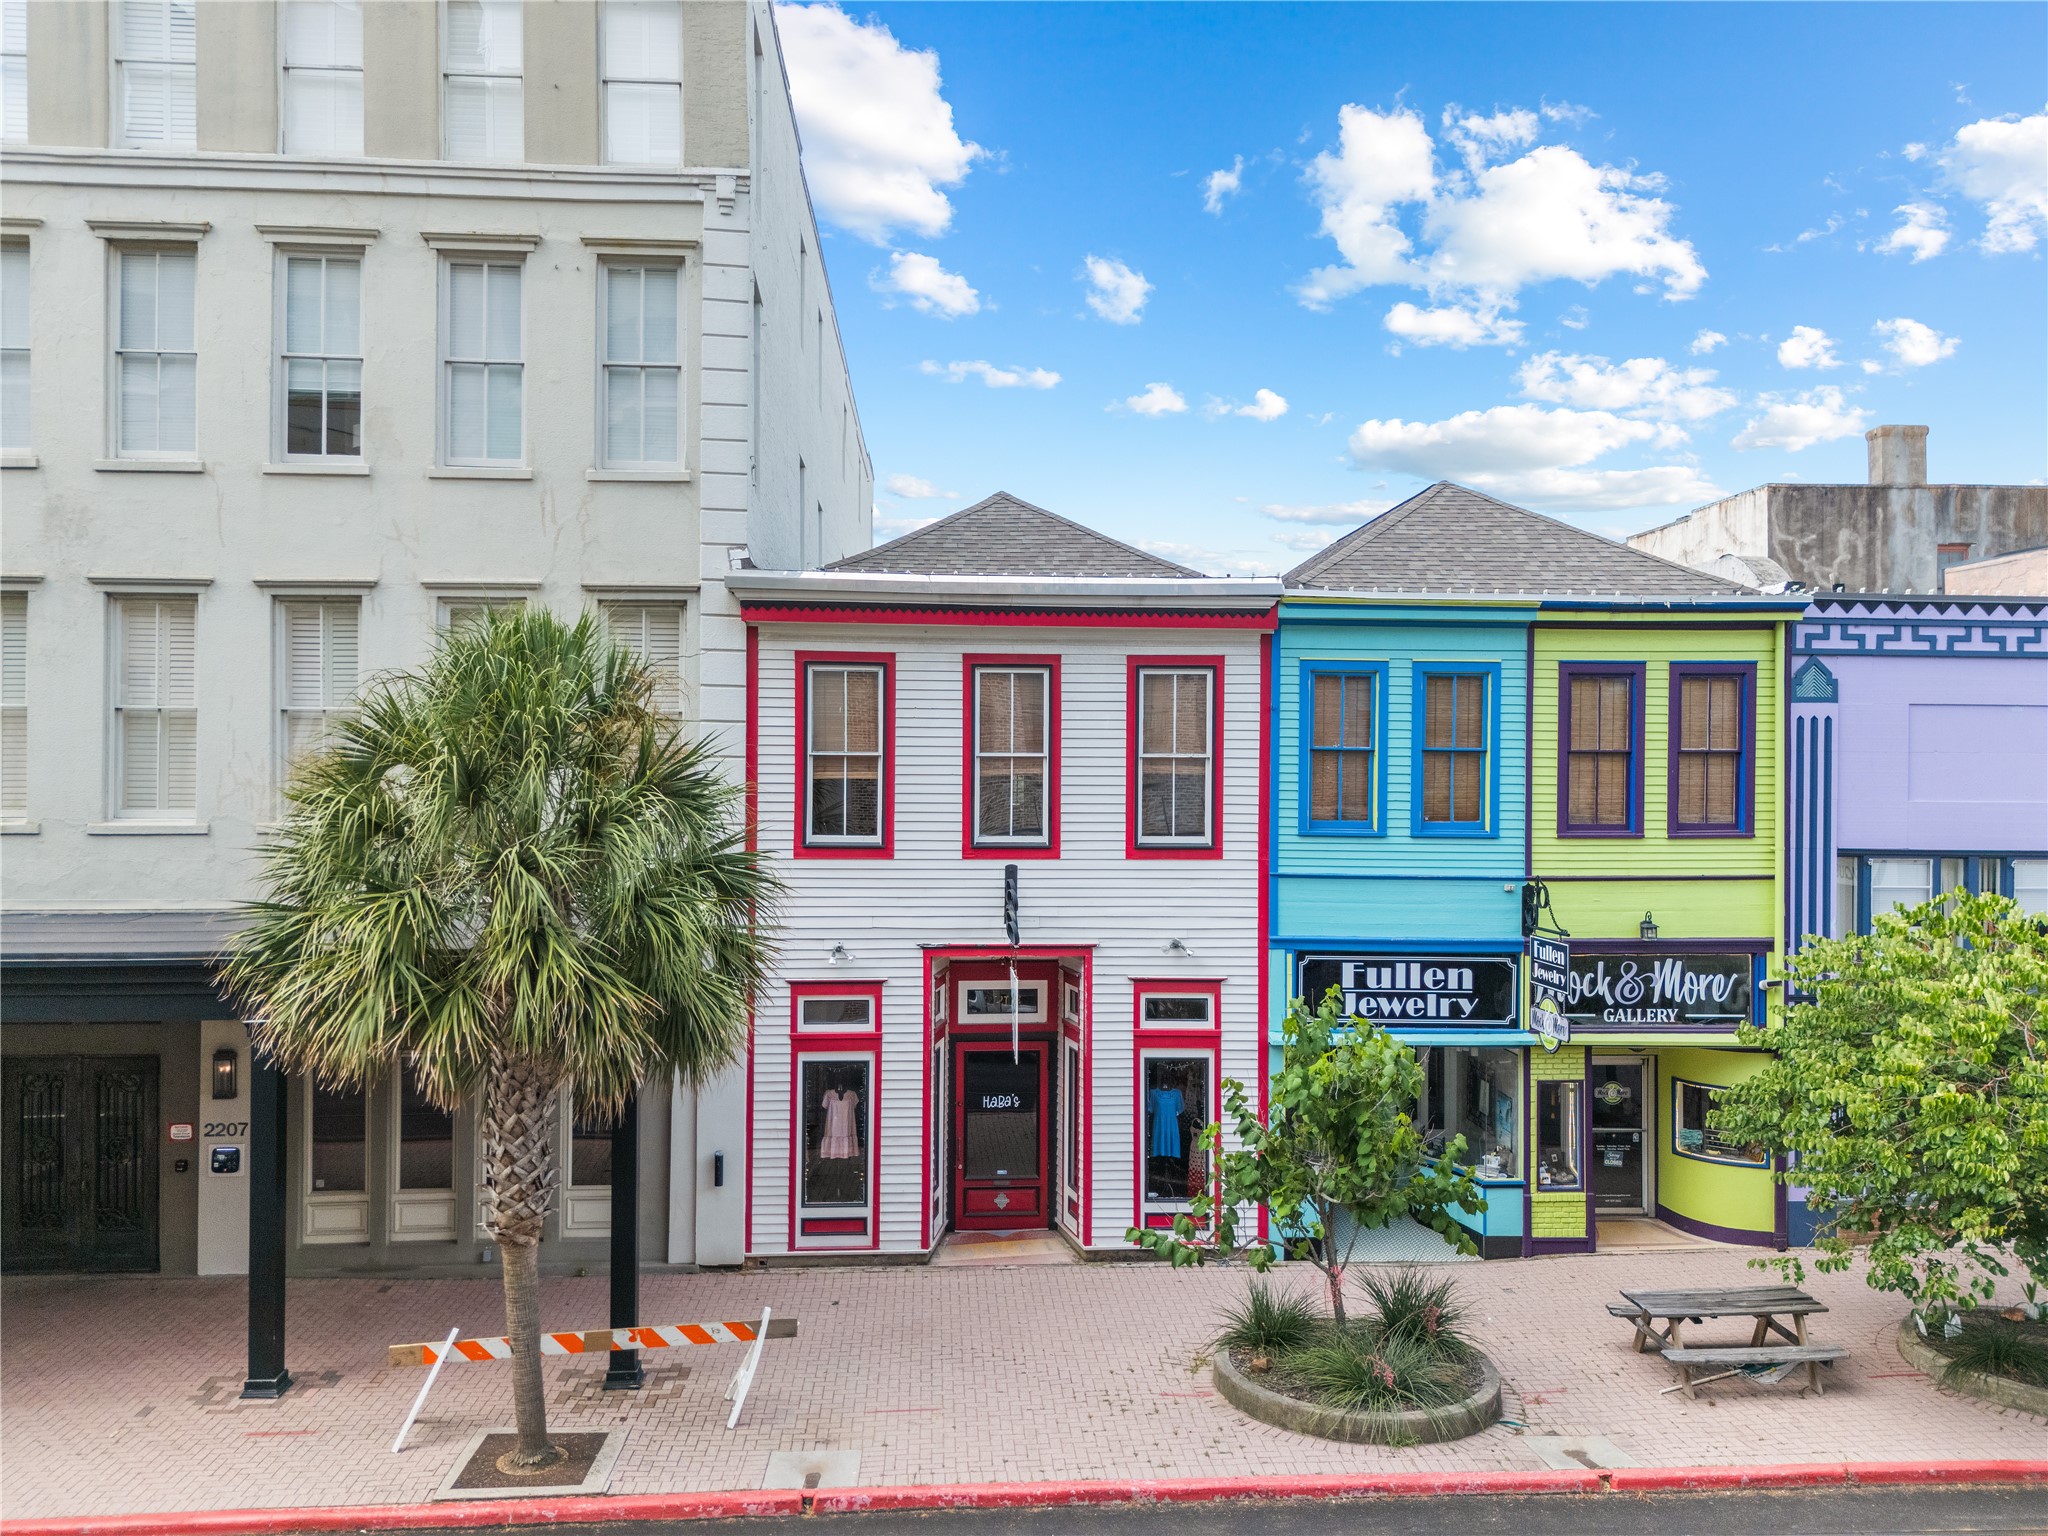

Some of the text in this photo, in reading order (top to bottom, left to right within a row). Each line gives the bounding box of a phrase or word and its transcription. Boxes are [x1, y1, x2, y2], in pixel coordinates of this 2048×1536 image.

[1534, 940, 1565, 966] Fullen
[1342, 962, 1473, 990] Fullen
[1532, 962, 1566, 987] Jewelry
[1614, 960, 1659, 1005] &
[1653, 958, 1738, 1005] More
[1340, 993, 1479, 1018] Jewelry
[1603, 1008, 1679, 1023] GALLERY
[204, 1122, 249, 1137] 2207
